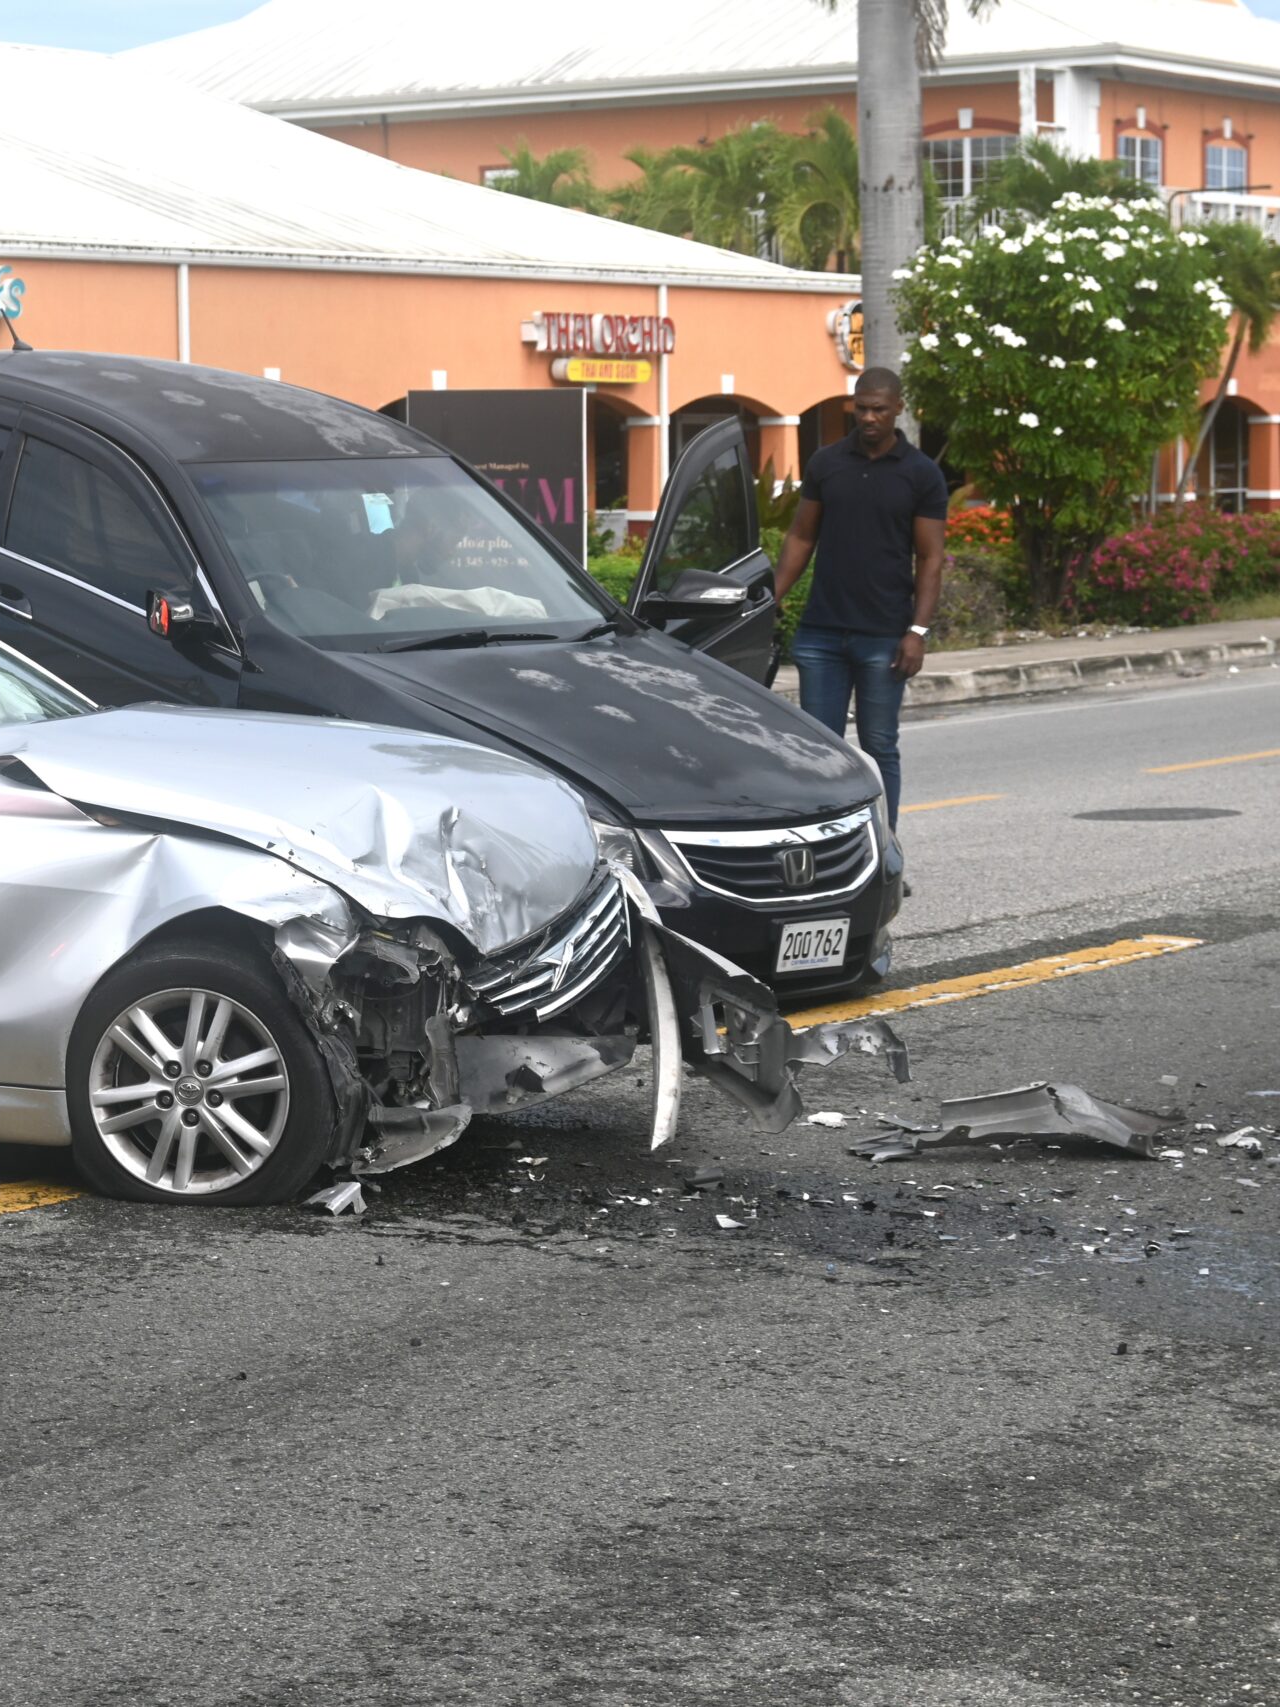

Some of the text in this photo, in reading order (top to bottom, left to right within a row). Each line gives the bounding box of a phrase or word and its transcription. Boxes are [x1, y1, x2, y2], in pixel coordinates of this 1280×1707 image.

[542, 311, 676, 355] THAI ORCHID
[489, 461, 520, 472] Managed
